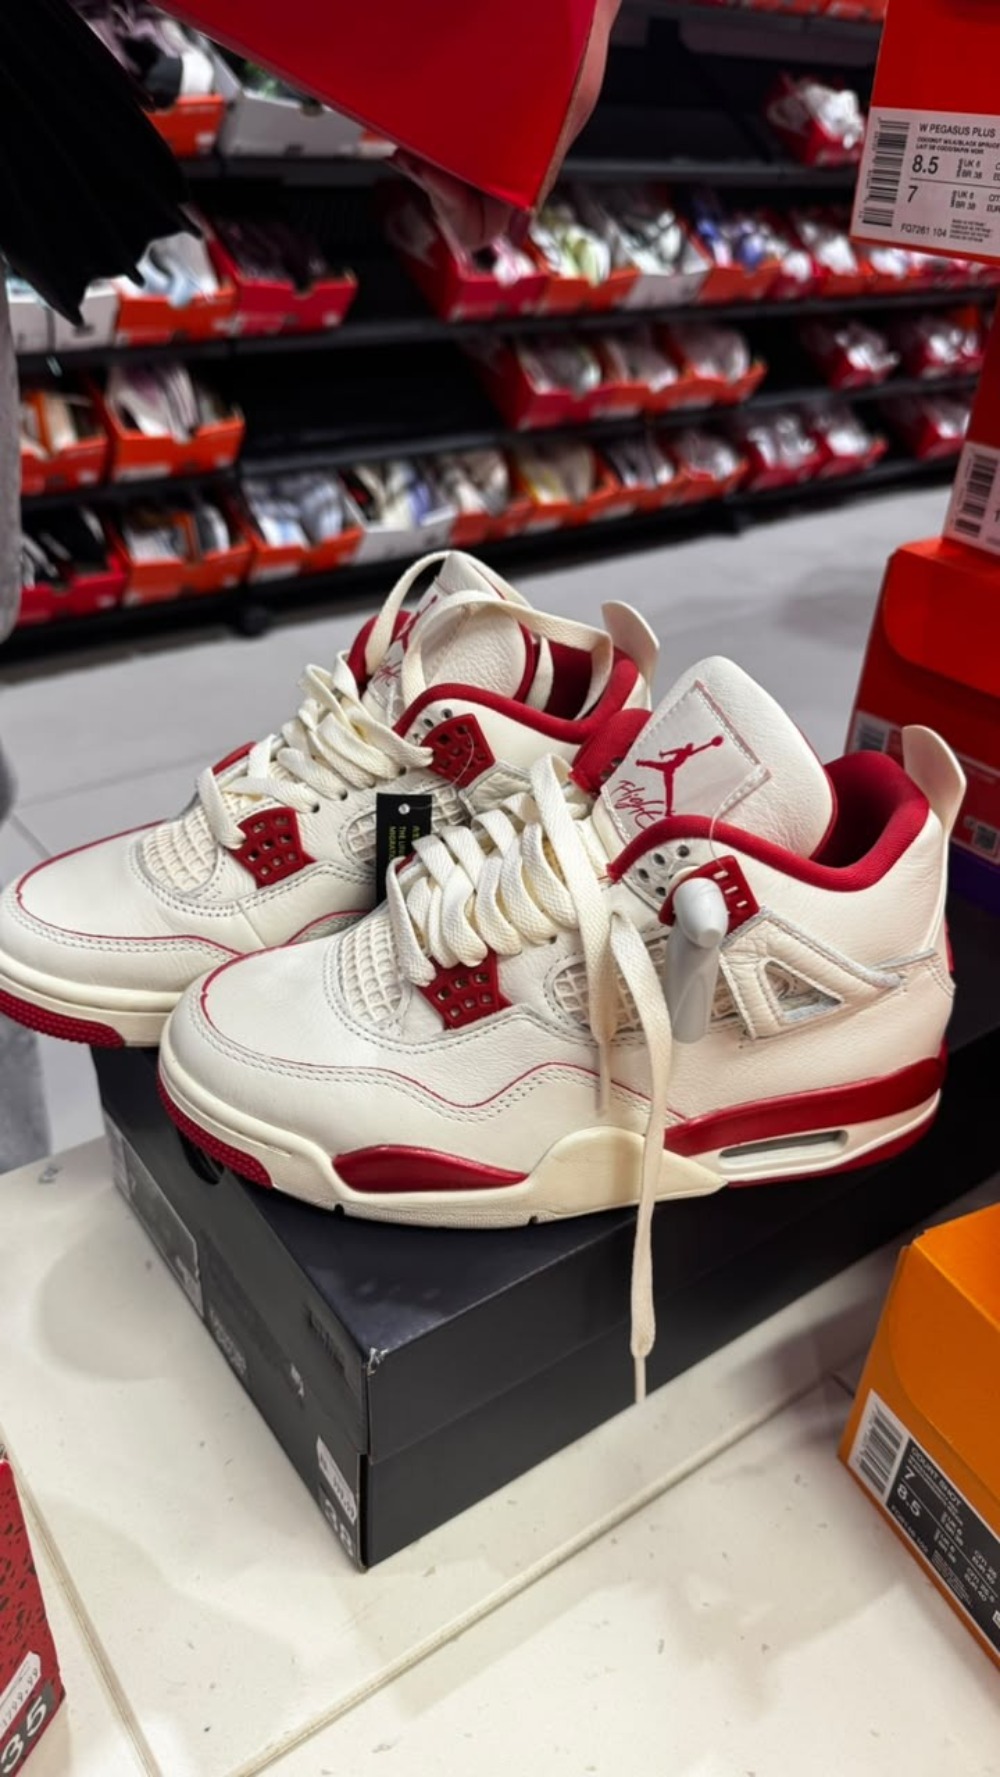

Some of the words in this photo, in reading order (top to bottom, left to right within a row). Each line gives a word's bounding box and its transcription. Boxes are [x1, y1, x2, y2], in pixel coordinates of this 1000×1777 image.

[919, 123, 928, 132] W
[929, 124, 970, 136] PEGASUS
[972, 127, 996, 138] PLUS
[912, 154, 939, 174] 8.5
[964, 159, 974, 167] UK
[907, 185, 918, 203] 7
[957, 190, 968, 198] UK
[933, 228, 947, 238] 104
[911, 1447, 939, 1480] COURT
[904, 1466, 915, 1479] 7
[897, 1483, 920, 1517] 8.5
[1, 1696, 47, 1774] 35
